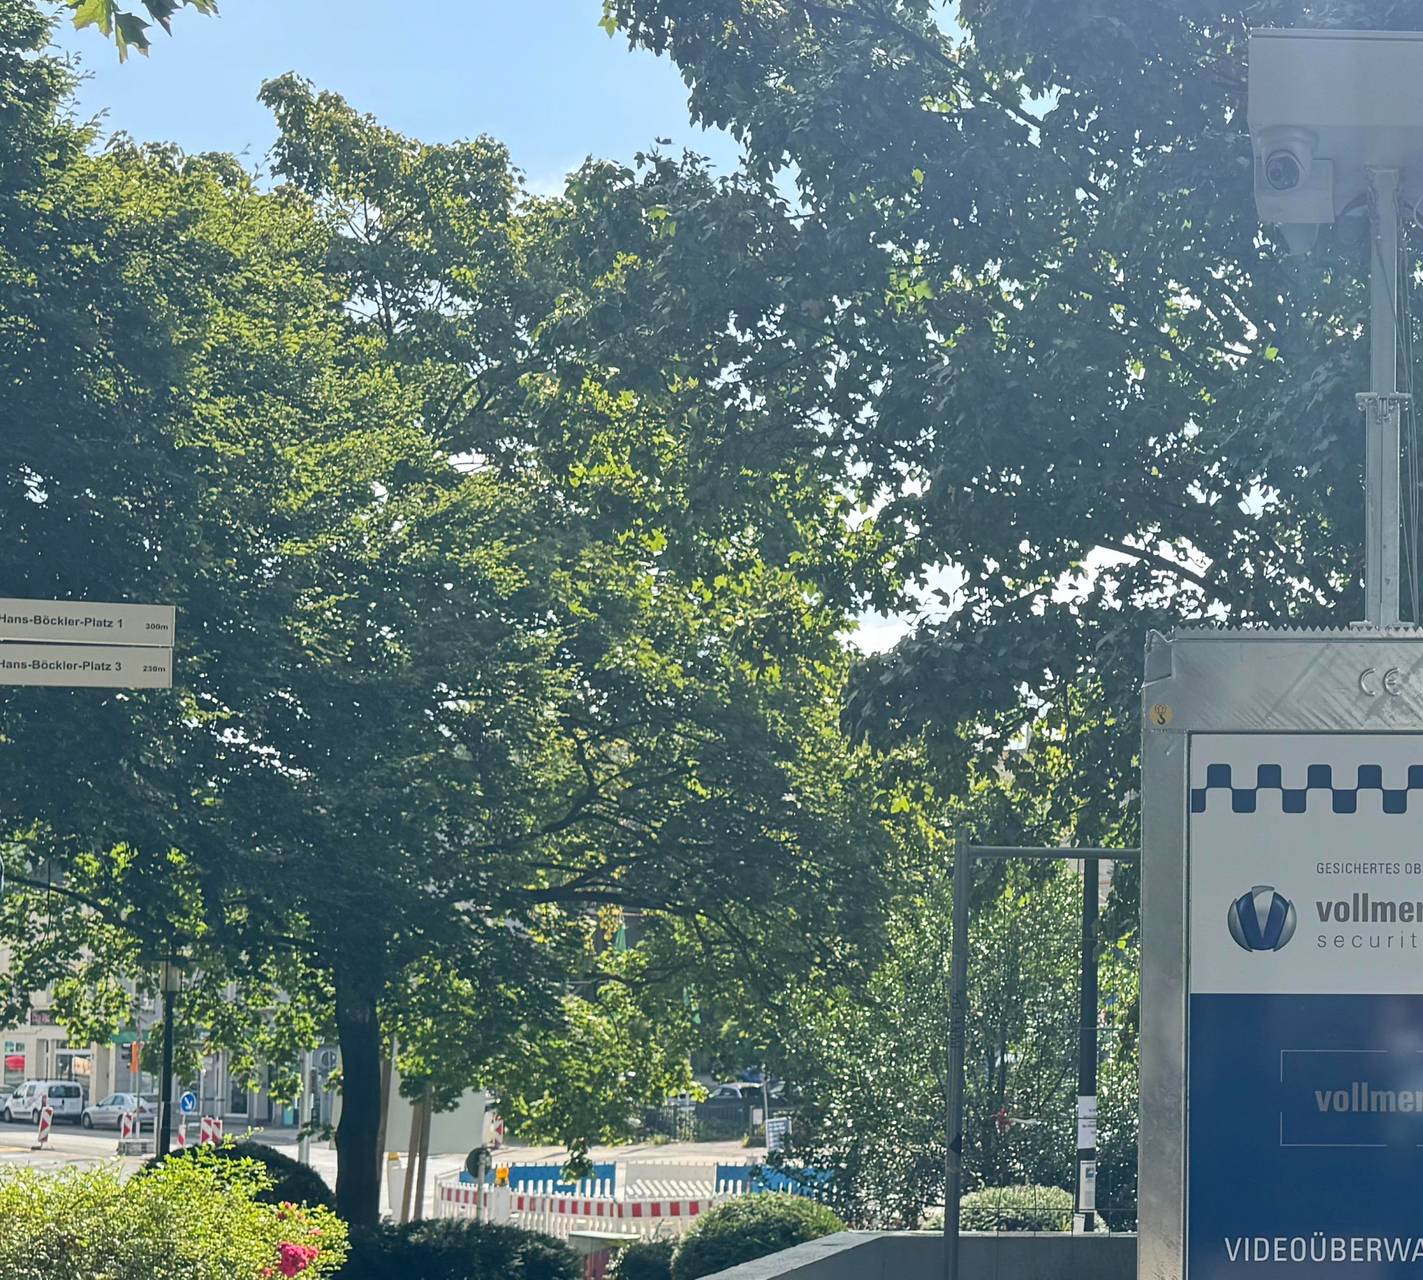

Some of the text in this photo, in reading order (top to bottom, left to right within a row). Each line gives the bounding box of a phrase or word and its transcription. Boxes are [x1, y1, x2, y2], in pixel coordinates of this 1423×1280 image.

[0, 613, 114, 629] Hans-Böckler-Platz
[117, 618, 123, 628] 1
[0, 659, 112, 672] Hans-Böckler-Platz
[115, 661, 122, 671] 3
[1316, 862, 1400, 875] GESICHERTES
